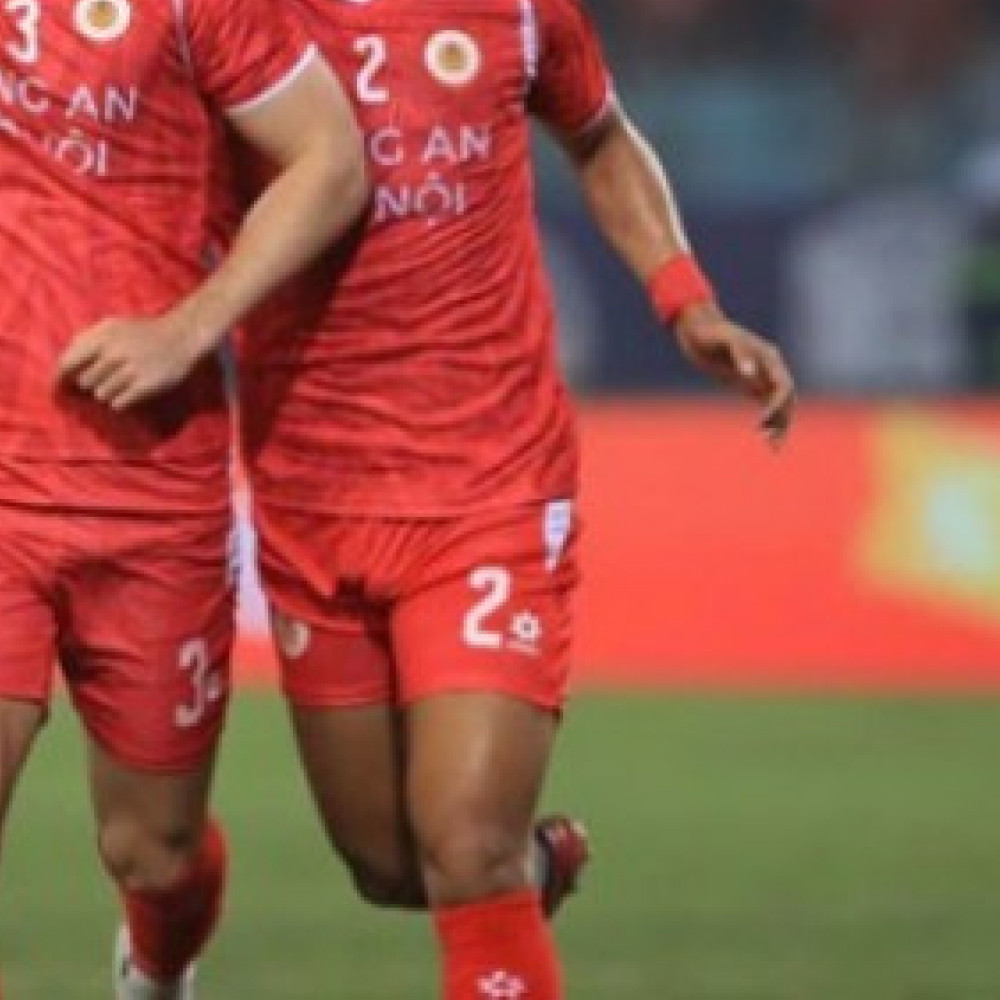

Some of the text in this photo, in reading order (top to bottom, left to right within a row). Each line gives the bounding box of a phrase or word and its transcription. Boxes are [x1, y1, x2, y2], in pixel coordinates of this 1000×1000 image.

[65, 83, 138, 120] AN
[353, 35, 390, 102] 2
[420, 124, 491, 165] AN
[462, 566, 512, 650] 2
[174, 638, 208, 728] 3
